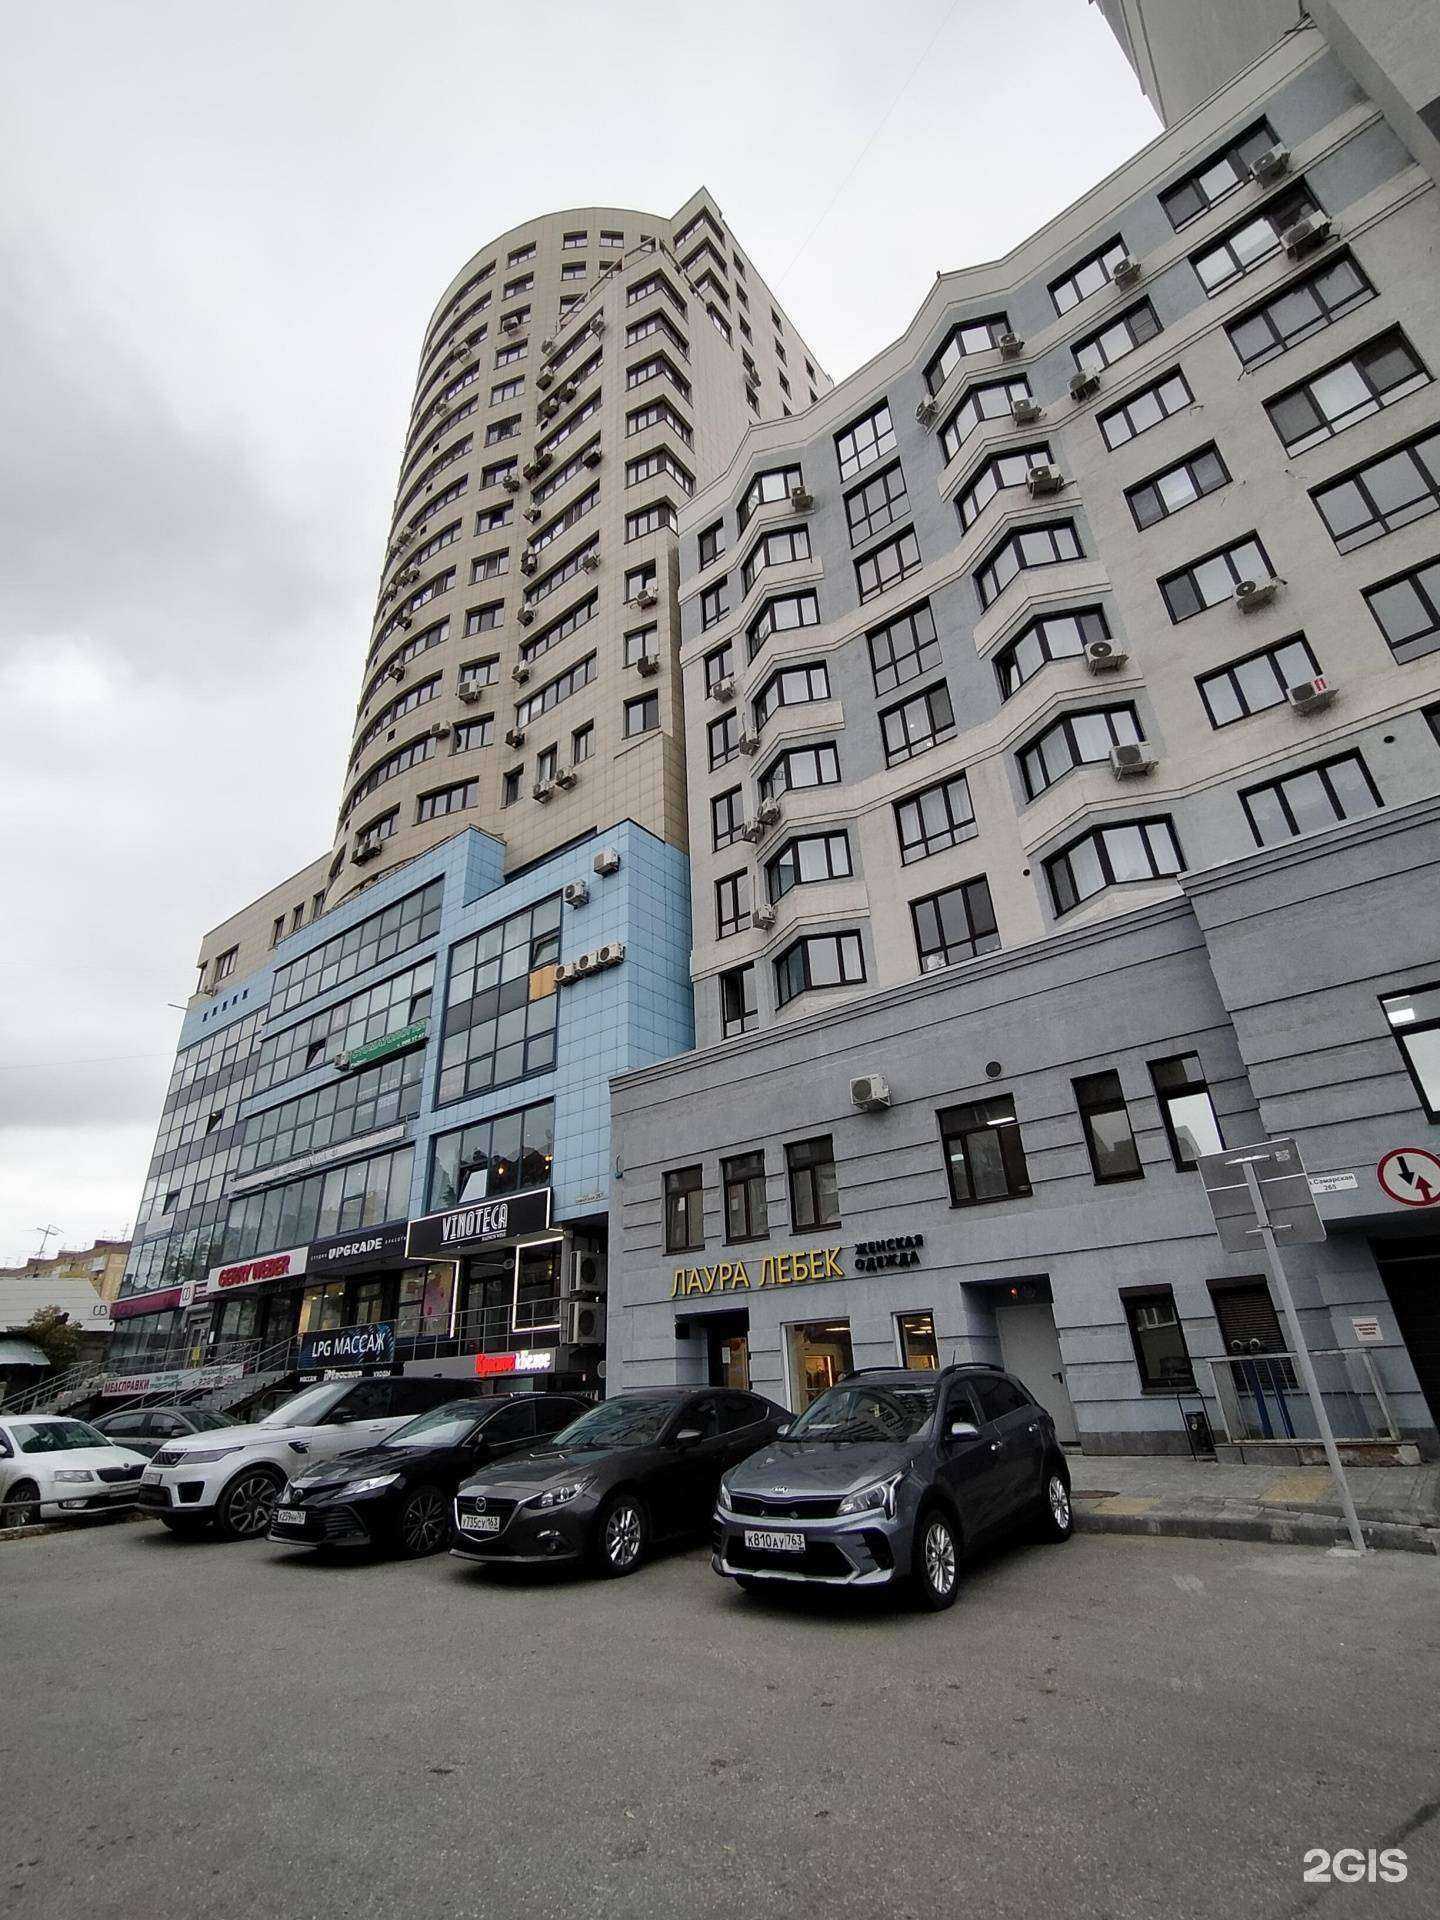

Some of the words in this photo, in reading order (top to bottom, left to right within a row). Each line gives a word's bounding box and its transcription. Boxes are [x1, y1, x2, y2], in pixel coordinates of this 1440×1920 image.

[442, 1203, 508, 1240] VINOTECA
[328, 1238, 383, 1260] UPGRADE
[855, 1234, 923, 1255] ЖЕНСКАЯ
[671, 1260, 750, 1297] ЛАУРА
[759, 1247, 844, 1287] ЛЕБЕК
[855, 1251, 920, 1272] ОДЕЖДА
[312, 1340, 331, 1357] LPG
[334, 1333, 385, 1356] МАССАЖ
[103, 1380, 149, 1393] МЕДСПРАВКИ
